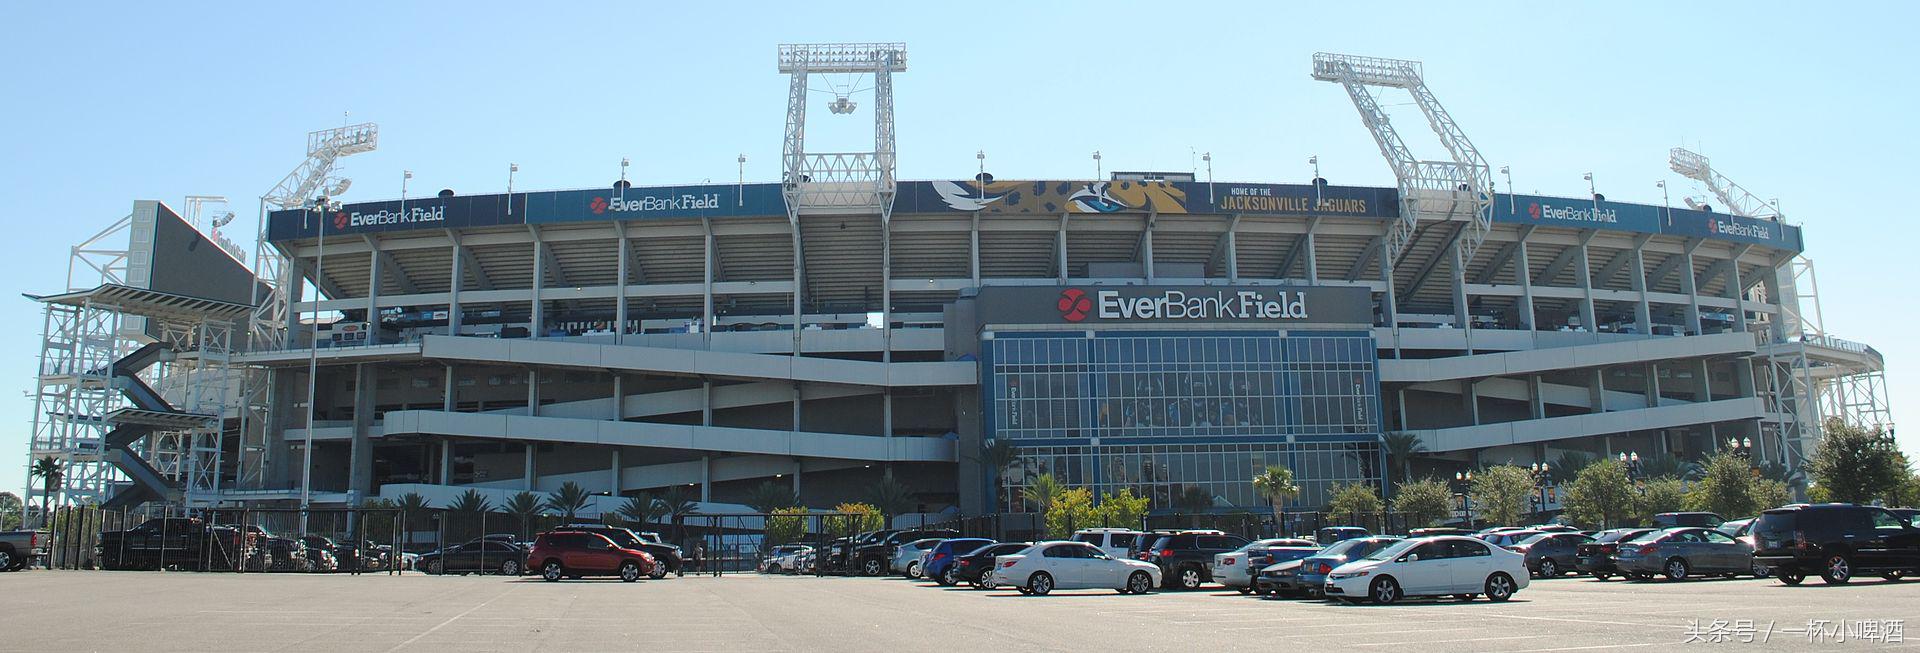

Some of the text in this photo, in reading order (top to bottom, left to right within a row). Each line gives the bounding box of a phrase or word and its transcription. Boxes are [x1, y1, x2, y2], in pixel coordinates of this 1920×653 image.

[1231, 187, 1271, 196] HOME OF THE
[611, 194, 719, 211] EverBank Field
[1221, 196, 1366, 213] JACKSONVILLE JAGUARS
[350, 206, 444, 227] EverBank Field
[1542, 204, 1591, 220] EverBank
[1718, 220, 1770, 239] EverBank Field
[1098, 290, 1308, 319] EverBank Field
